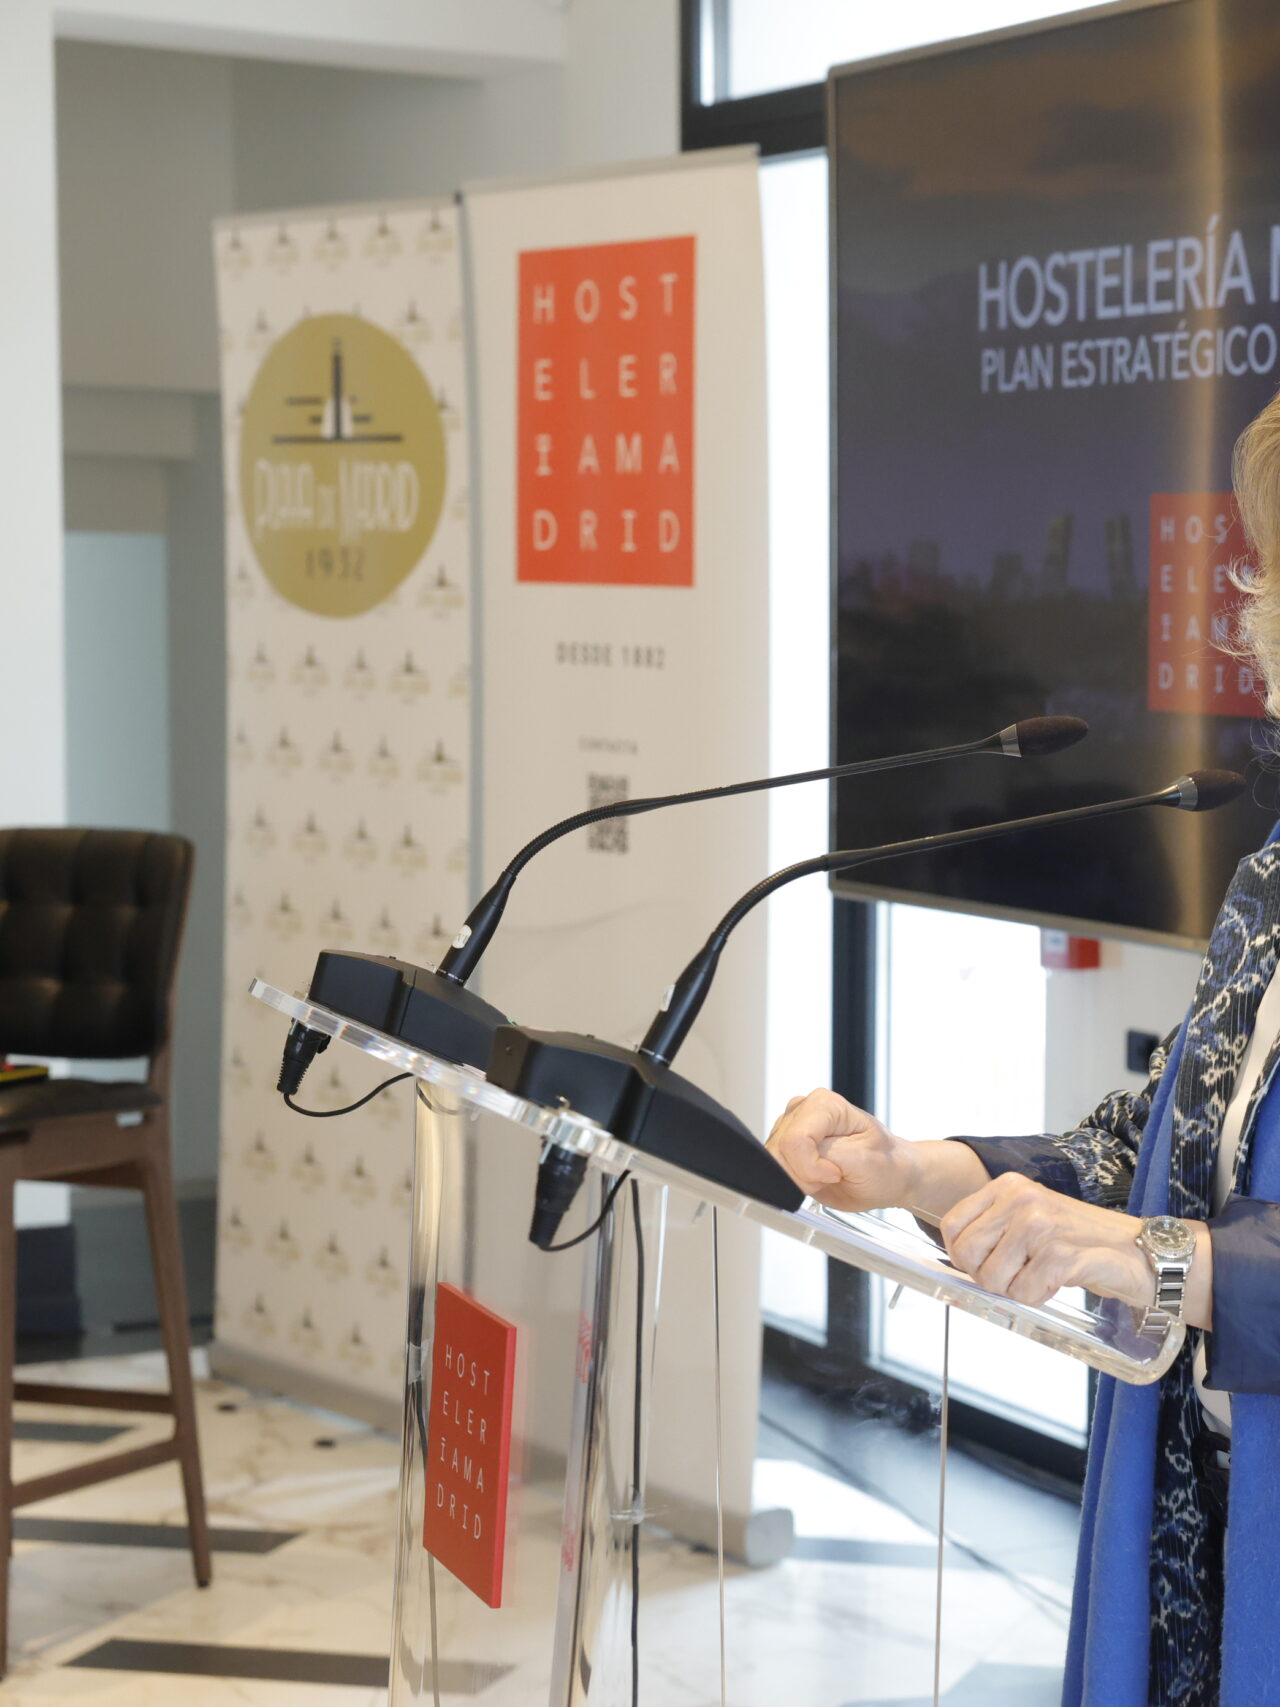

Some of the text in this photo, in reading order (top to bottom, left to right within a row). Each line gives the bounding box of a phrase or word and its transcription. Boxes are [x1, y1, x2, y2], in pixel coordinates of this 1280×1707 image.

[532, 271, 679, 324] HOST
[978, 213, 1256, 332] HOSTELERÍA
[532, 352, 679, 402] ELER
[980, 346, 1054, 394] PLAN
[1061, 318, 1278, 388] ESTRATÉGICO
[532, 509, 681, 553] DRID
[1160, 514, 1250, 544] HOS
[445, 1343, 490, 1396] HOST
[442, 1390, 487, 1445] ELER
[436, 1483, 482, 1540] DRID
